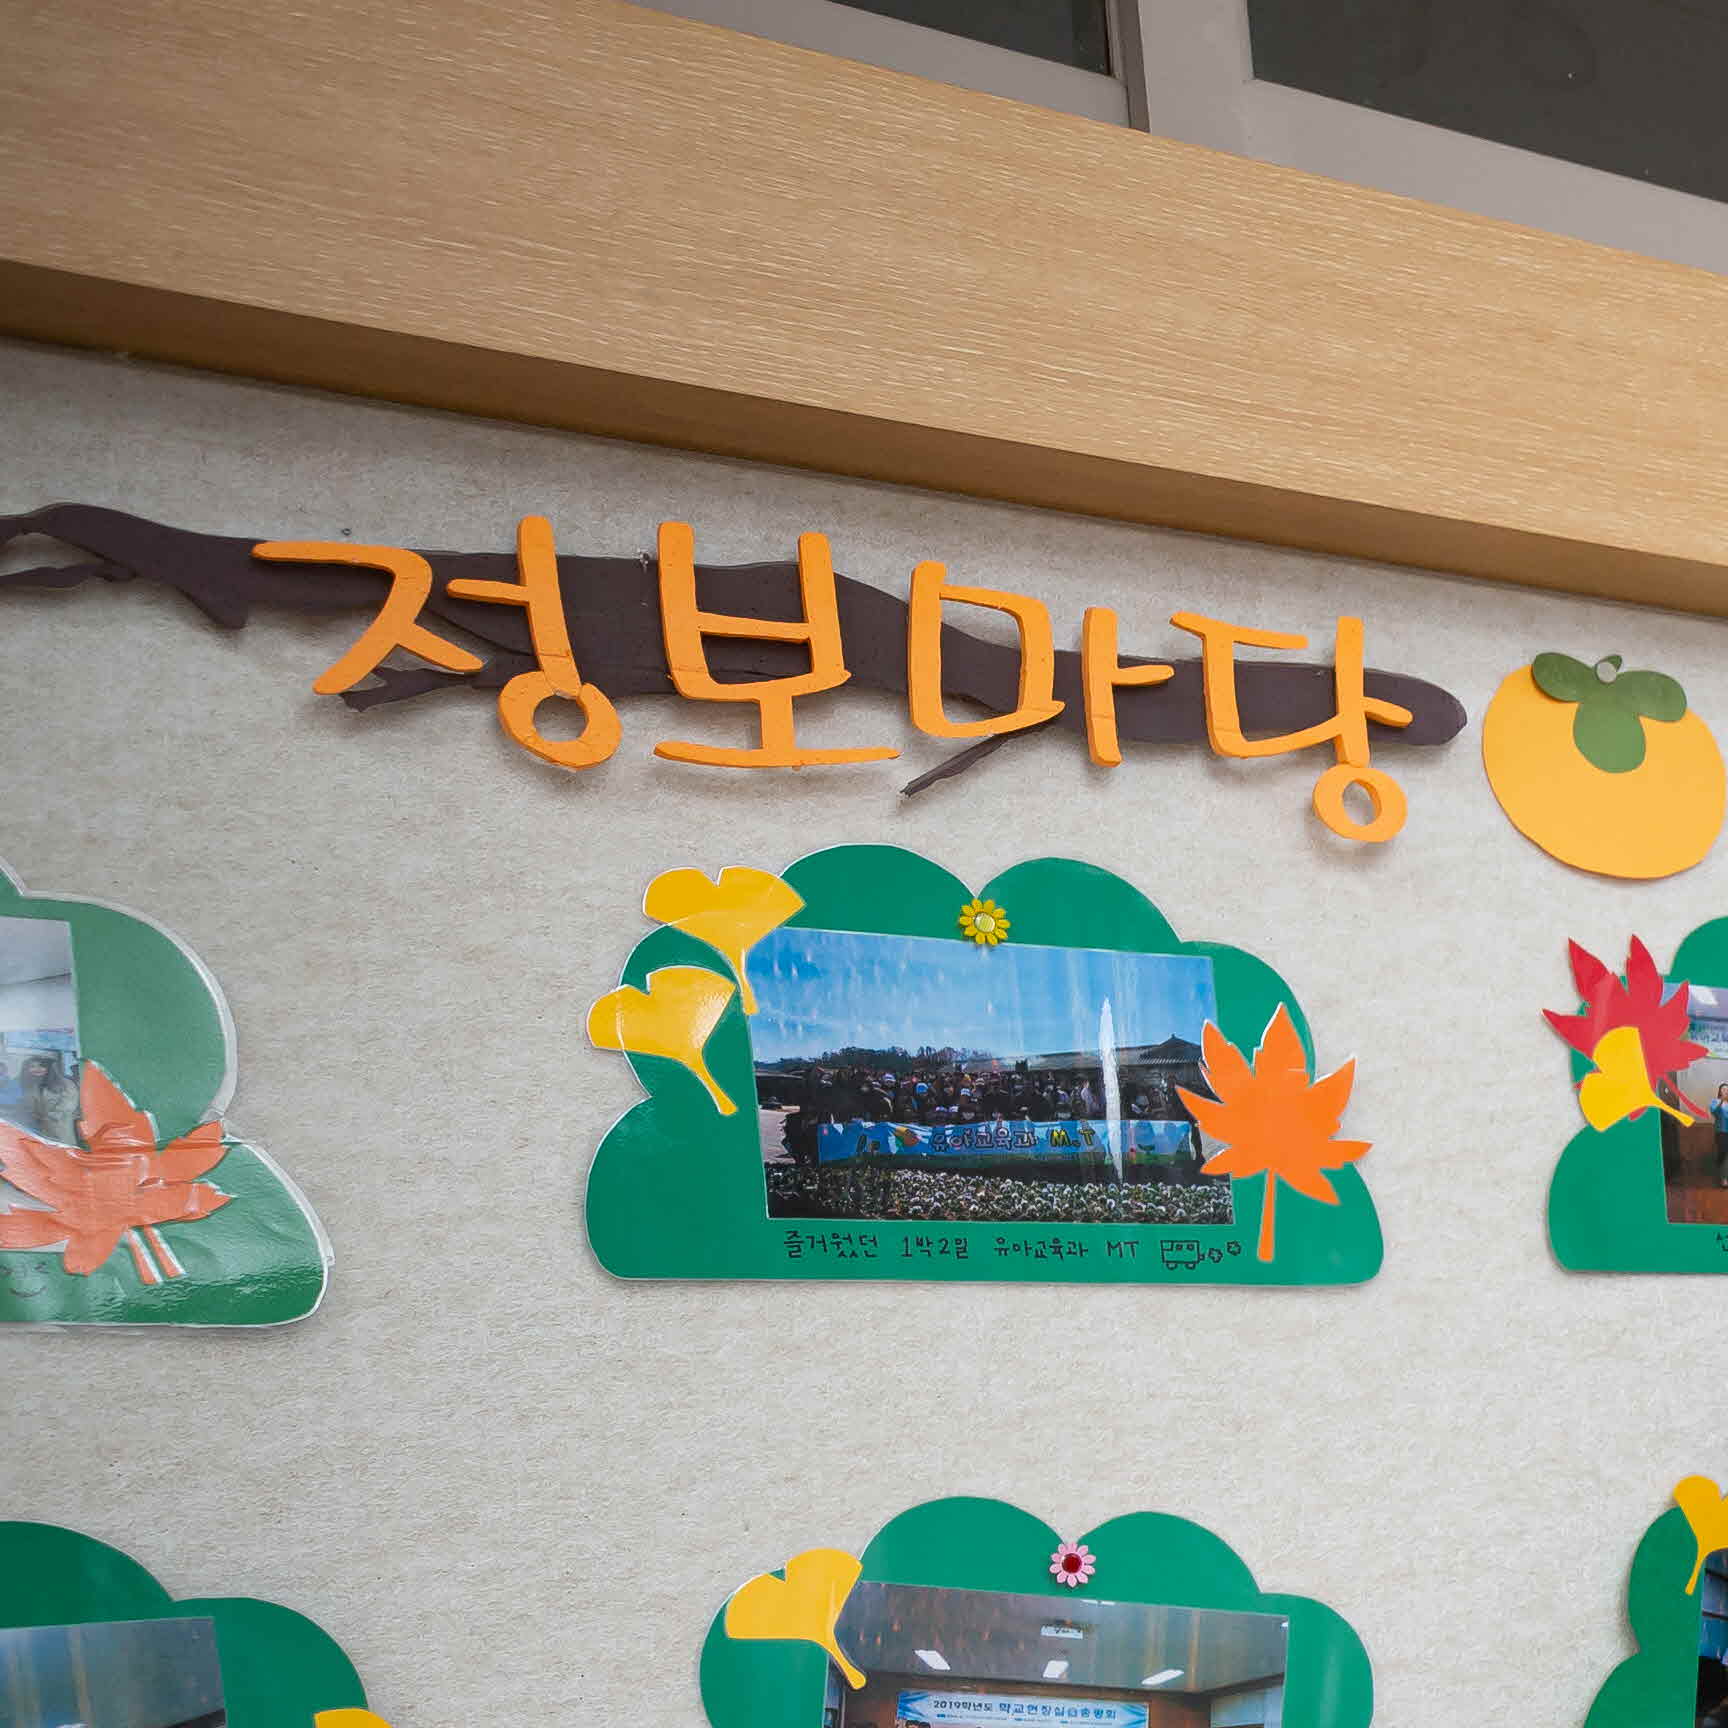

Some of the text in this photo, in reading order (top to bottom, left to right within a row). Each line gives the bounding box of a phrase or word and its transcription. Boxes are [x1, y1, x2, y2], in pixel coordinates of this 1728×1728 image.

[251, 514, 1414, 844] 정보마당
[931, 1123, 1039, 1151] 유아교육과
[783, 1229, 1141, 1260] 즐거웠던 1박2일 유아교육과 MT
